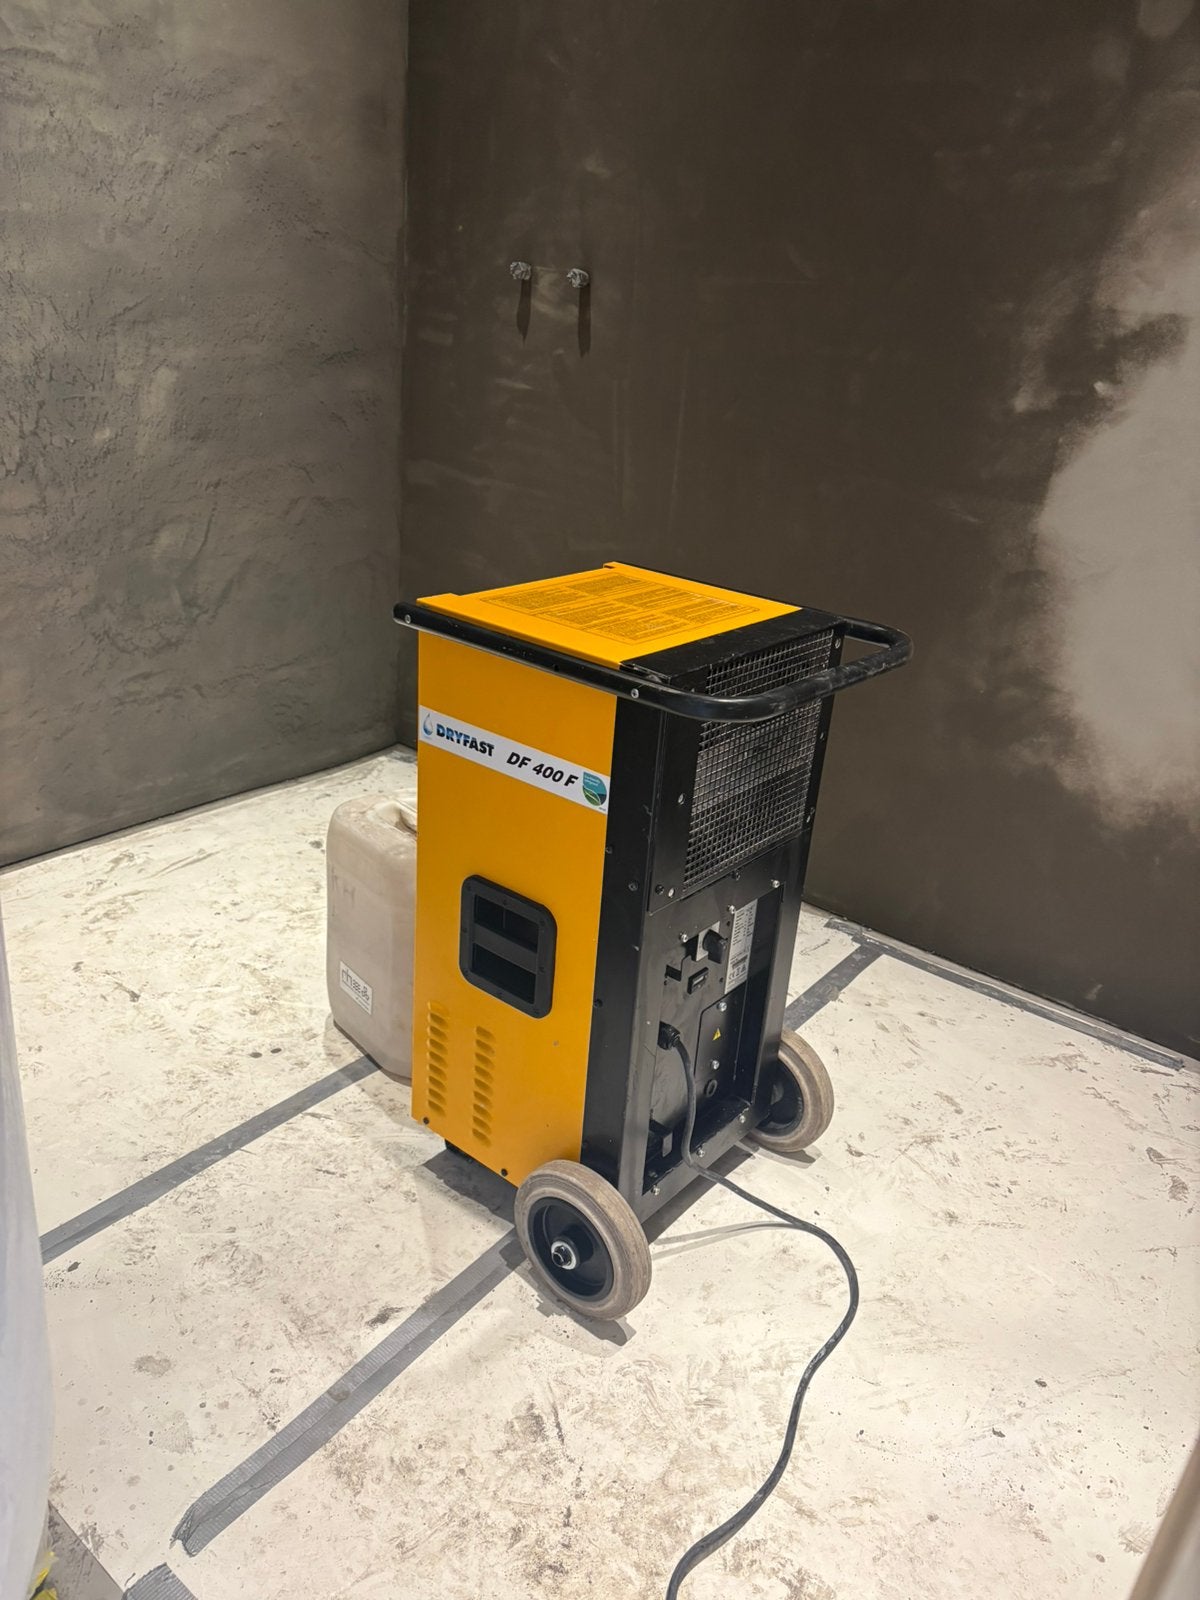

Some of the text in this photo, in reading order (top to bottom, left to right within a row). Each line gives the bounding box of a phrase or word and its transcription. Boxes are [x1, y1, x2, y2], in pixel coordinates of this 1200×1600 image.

[436, 723, 495, 757] DRYFAST
[506, 752, 531, 769] DF
[532, 763, 564, 783] 400
[564, 774, 579, 787] F
